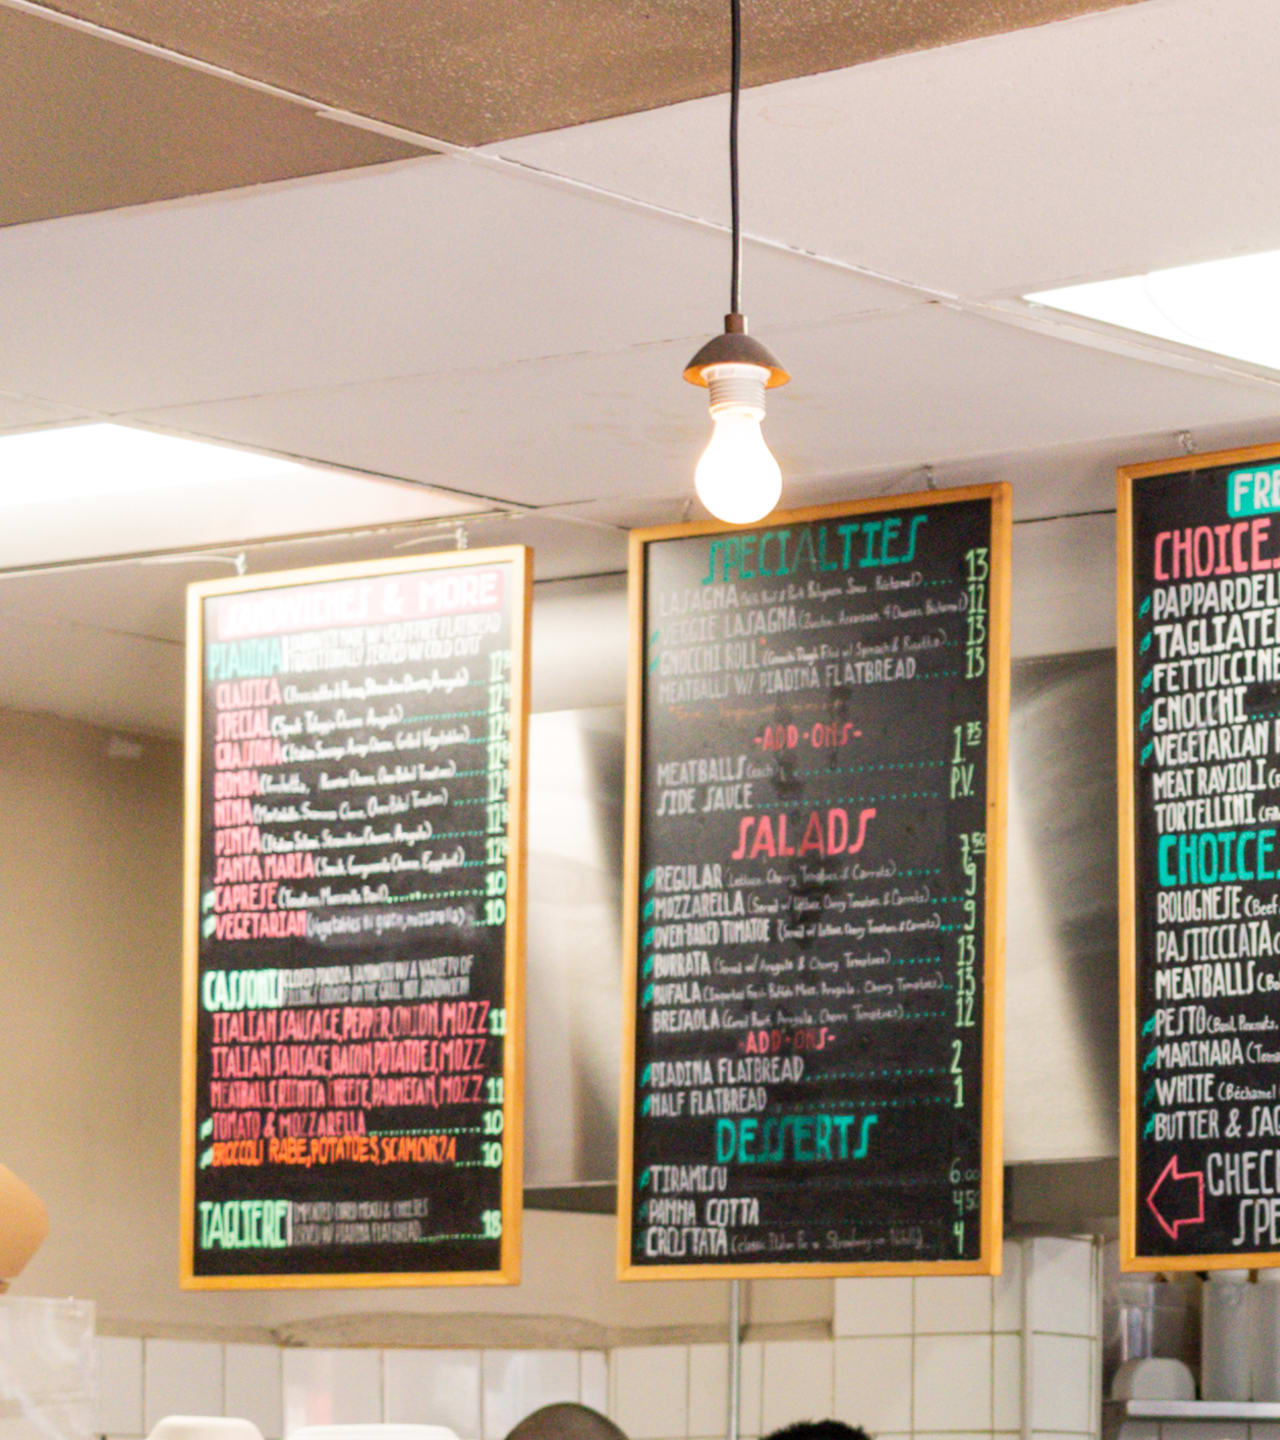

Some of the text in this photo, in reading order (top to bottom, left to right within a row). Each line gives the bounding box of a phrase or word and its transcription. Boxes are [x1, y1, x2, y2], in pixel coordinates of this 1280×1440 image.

[702, 515, 928, 586] SPECIALTIES
[966, 548, 988, 581] 13
[419, 573, 497, 612] MORE
[725, 607, 796, 637] LASAGNA
[967, 584, 986, 614] 12
[966, 615, 985, 645] 13
[760, 646, 985, 694] PIADINA FLATBREAD 13
[216, 710, 271, 741] SPECIAL
[1153, 687, 1248, 732] GNOCCHI
[1153, 719, 1269, 766] VEGETARIAN
[215, 771, 261, 797] BOMBA
[657, 755, 747, 786] MEATBALLS
[1153, 769, 1194, 800] MEAT
[1198, 759, 1266, 795] RAVIOLI
[215, 799, 253, 826] NINA
[657, 783, 753, 816] SIDE SAUCE
[1154, 793, 1256, 834] TORTELLINI
[215, 826, 261, 855] PINTA
[732, 807, 877, 860] SALADS
[214, 855, 262, 883] SANTA
[264, 853, 314, 879] MARIA
[654, 863, 723, 892] REGULAR
[214, 883, 278, 912] CAPRESE
[486, 871, 506, 895] 10
[653, 890, 745, 919] MOZZARELLA
[1157, 885, 1242, 924] BOLOGNESE
[1244, 894, 1278, 918] (Beef
[216, 910, 306, 940] VEGETARIAN
[486, 899, 506, 925] 10
[653, 951, 710, 978] BURRATA
[957, 935, 976, 966] 13
[1157, 920, 1273, 963] PASTICCIATA
[204, 969, 279, 1011] CASSONI
[1155, 960, 1256, 1000] MEATBALLS
[652, 1007, 720, 1033] BRESAOLA
[956, 997, 975, 1028] 12
[1155, 1005, 1206, 1036] PESTO
[1155, 1038, 1244, 1070] MARINARA
[650, 1055, 804, 1088] PIADINA FLATBREAD
[650, 1087, 767, 1117] HALF FLATBREAD
[1155, 1073, 1215, 1106] WHITE
[279, 1110, 502, 1139] MOZZARELLA 10
[715, 1114, 878, 1164] DESSERTS
[1154, 1106, 1220, 1141] BUTTER
[1225, 1108, 1241, 1139] &
[482, 1142, 502, 1167] 10
[650, 1166, 727, 1193] TIRAMISU
[199, 1200, 288, 1249] TAGLIERE
[649, 1197, 760, 1227] PANNA COTTA
[645, 1227, 727, 1257] CROSTATA
